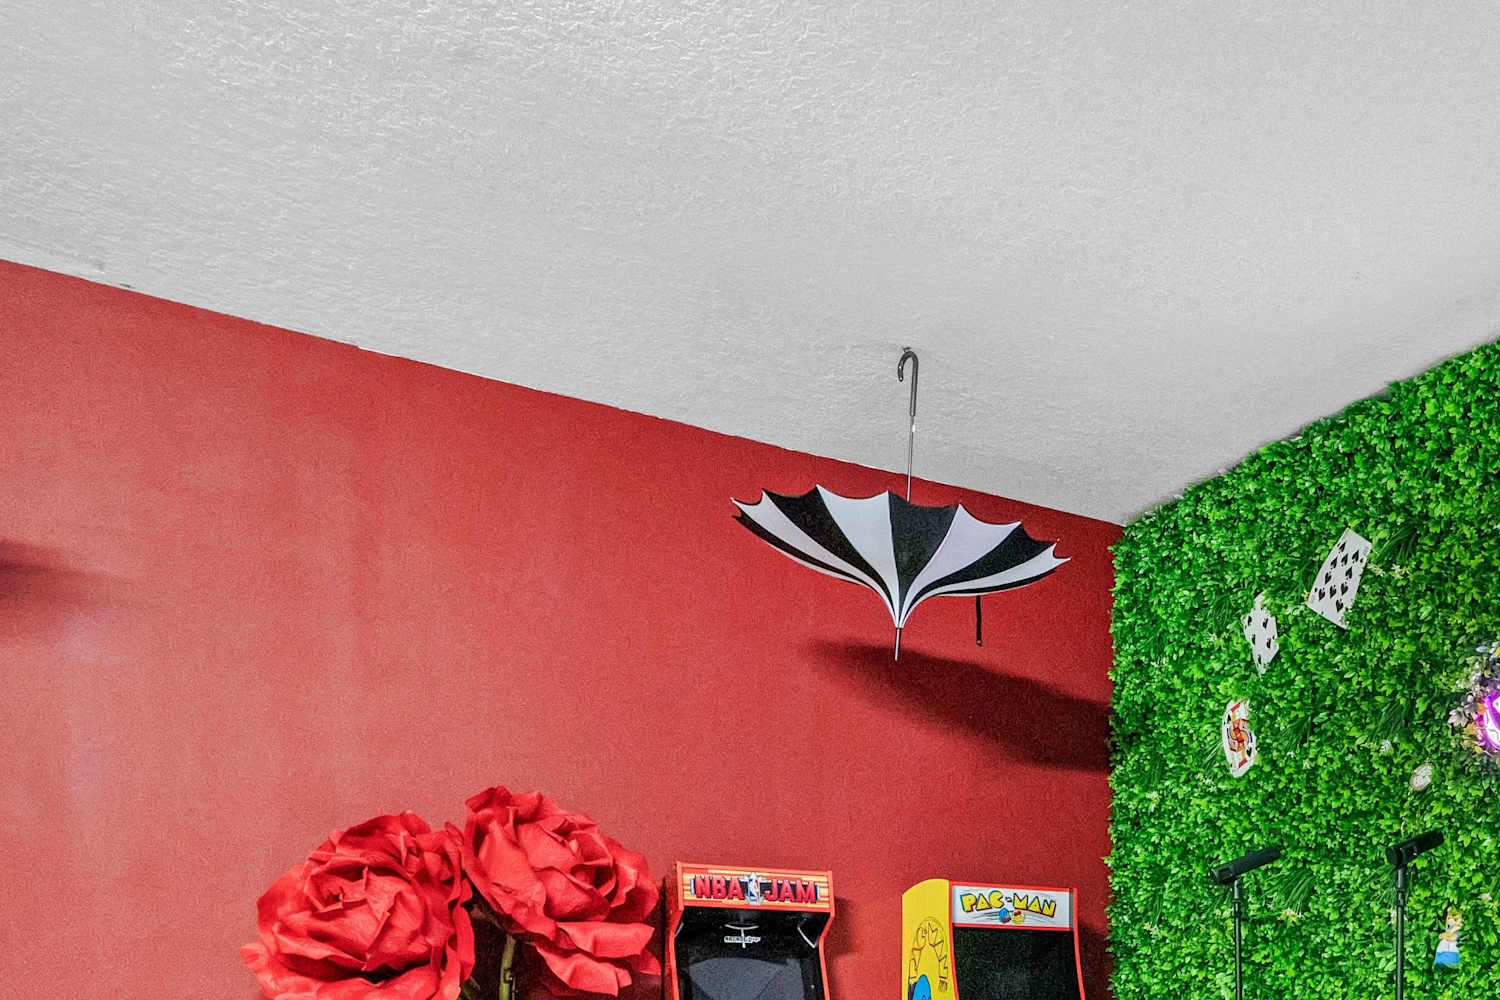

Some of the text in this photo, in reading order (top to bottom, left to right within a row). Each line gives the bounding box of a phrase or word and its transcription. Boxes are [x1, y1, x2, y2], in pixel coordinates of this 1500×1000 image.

[694, 874, 817, 903] NBA JAM
[960, 890, 1057, 918] PAC-MAN
